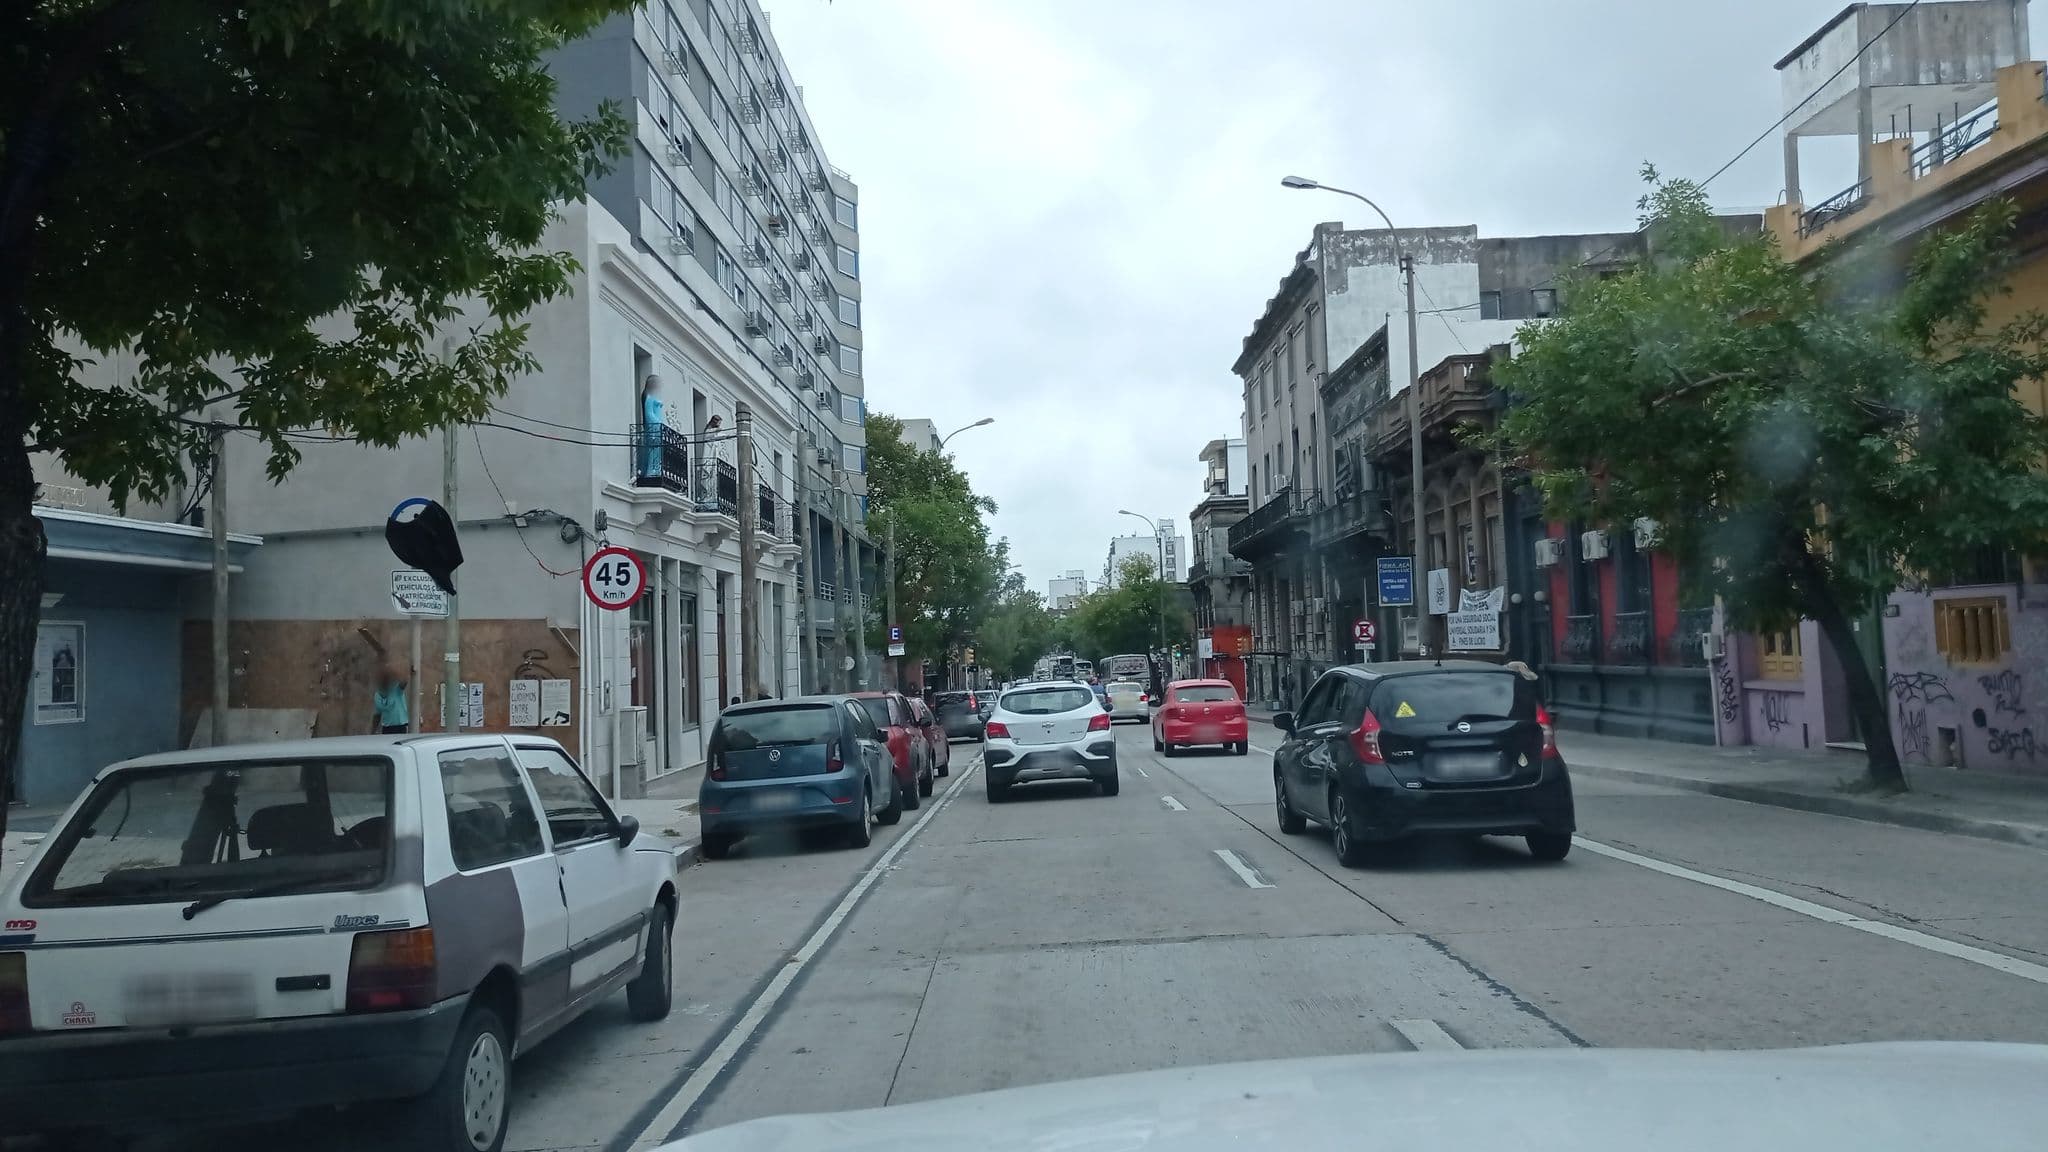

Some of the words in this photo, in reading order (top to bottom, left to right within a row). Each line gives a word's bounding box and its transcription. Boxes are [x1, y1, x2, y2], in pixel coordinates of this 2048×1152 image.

[596, 562, 631, 587] 45
[603, 590, 626, 599] Km/h
[892, 628, 899, 640] E
